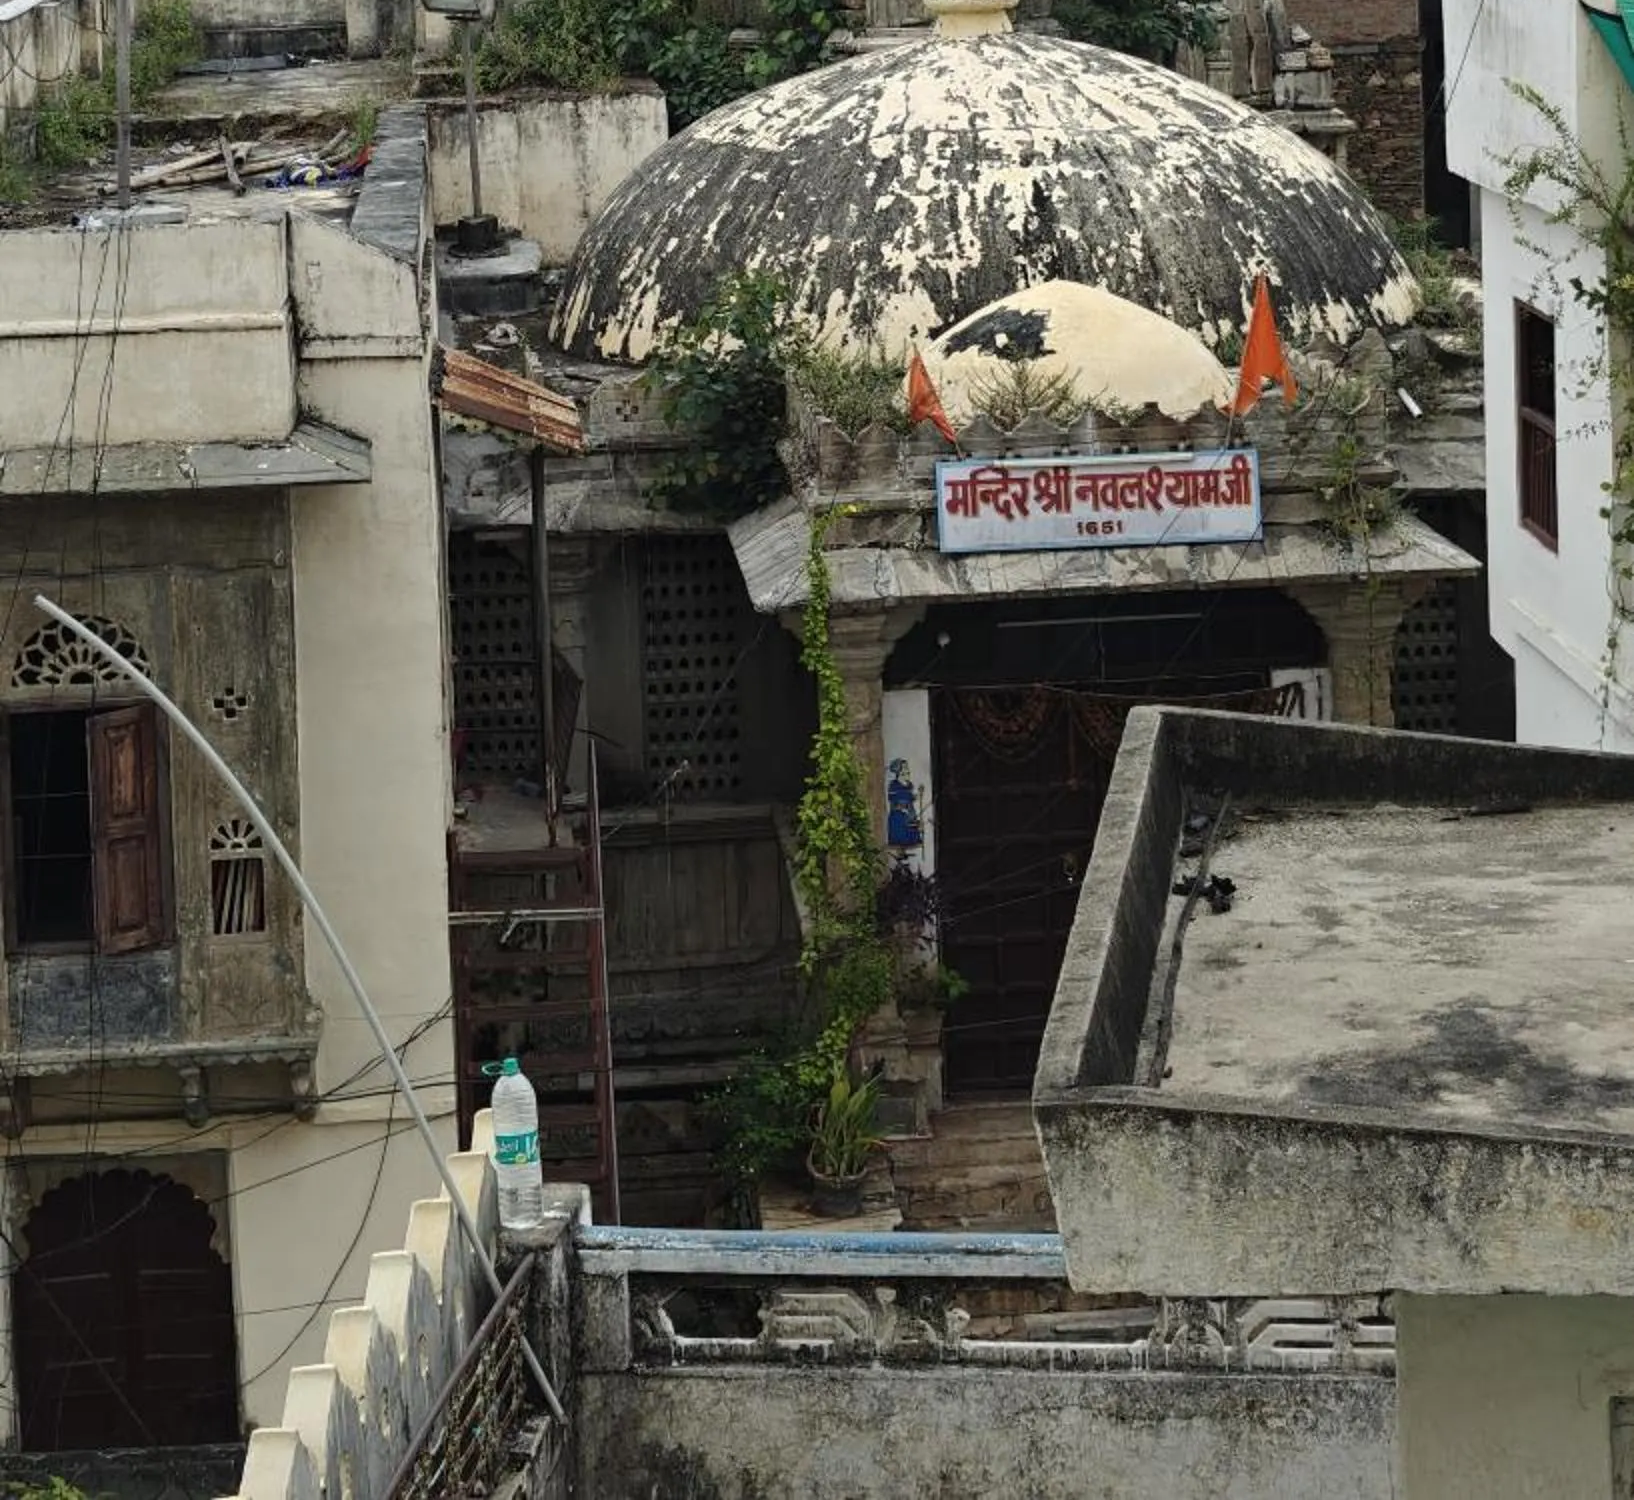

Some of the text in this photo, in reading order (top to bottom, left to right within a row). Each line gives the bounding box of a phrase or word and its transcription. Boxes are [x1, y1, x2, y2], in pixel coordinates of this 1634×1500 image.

[944, 465, 1029, 520] मन्दिर
[1033, 465, 1071, 514] श्री
[1077, 520, 1123, 535] 1651
